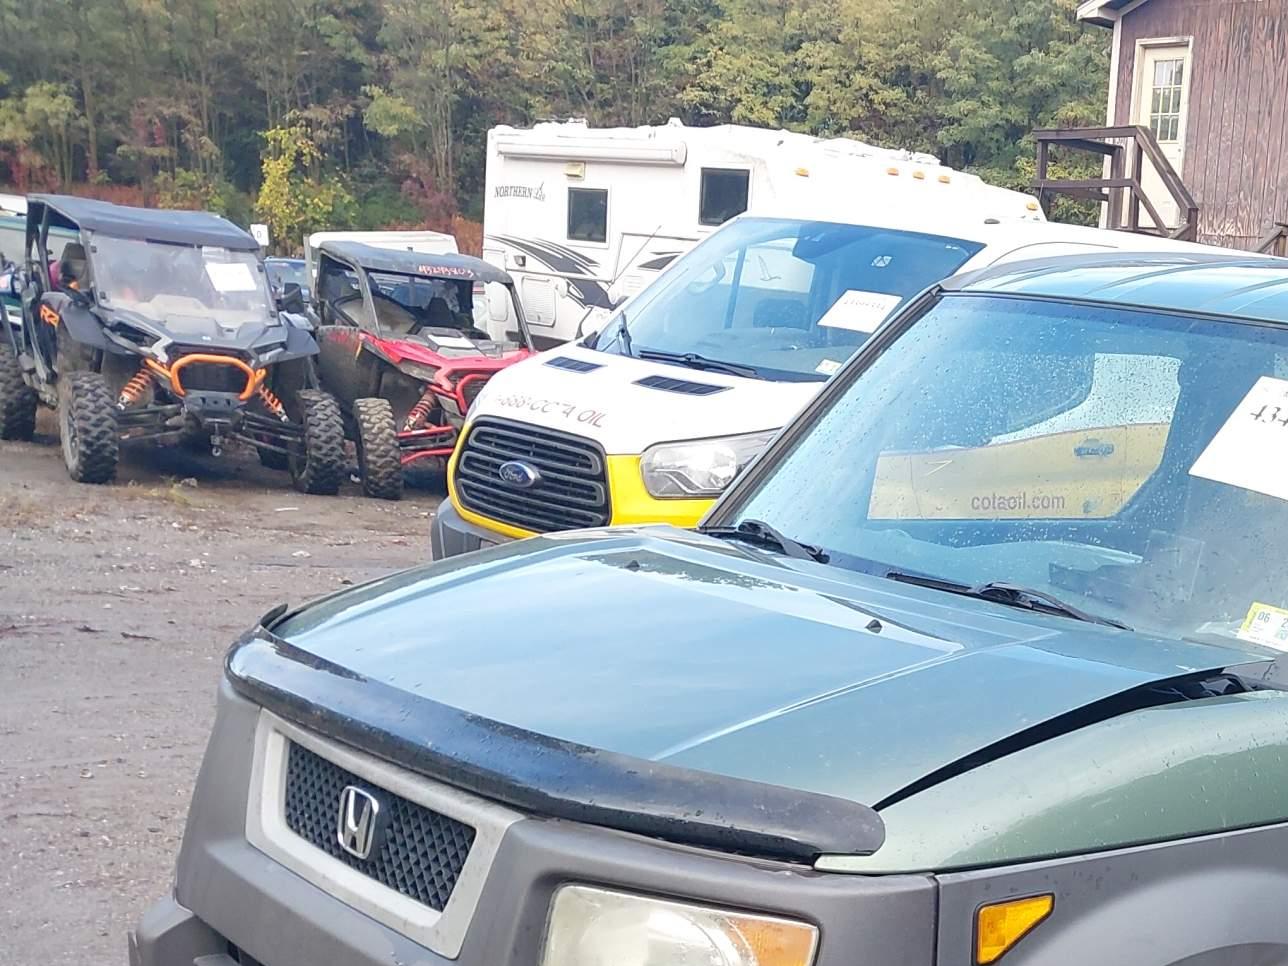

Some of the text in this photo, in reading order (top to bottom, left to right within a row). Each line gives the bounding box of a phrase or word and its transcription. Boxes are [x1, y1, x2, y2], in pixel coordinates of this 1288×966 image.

[494, 185, 532, 198] NORTHERN
[577, 408, 606, 428] OIL
[1257, 611, 1271, 624] 06
